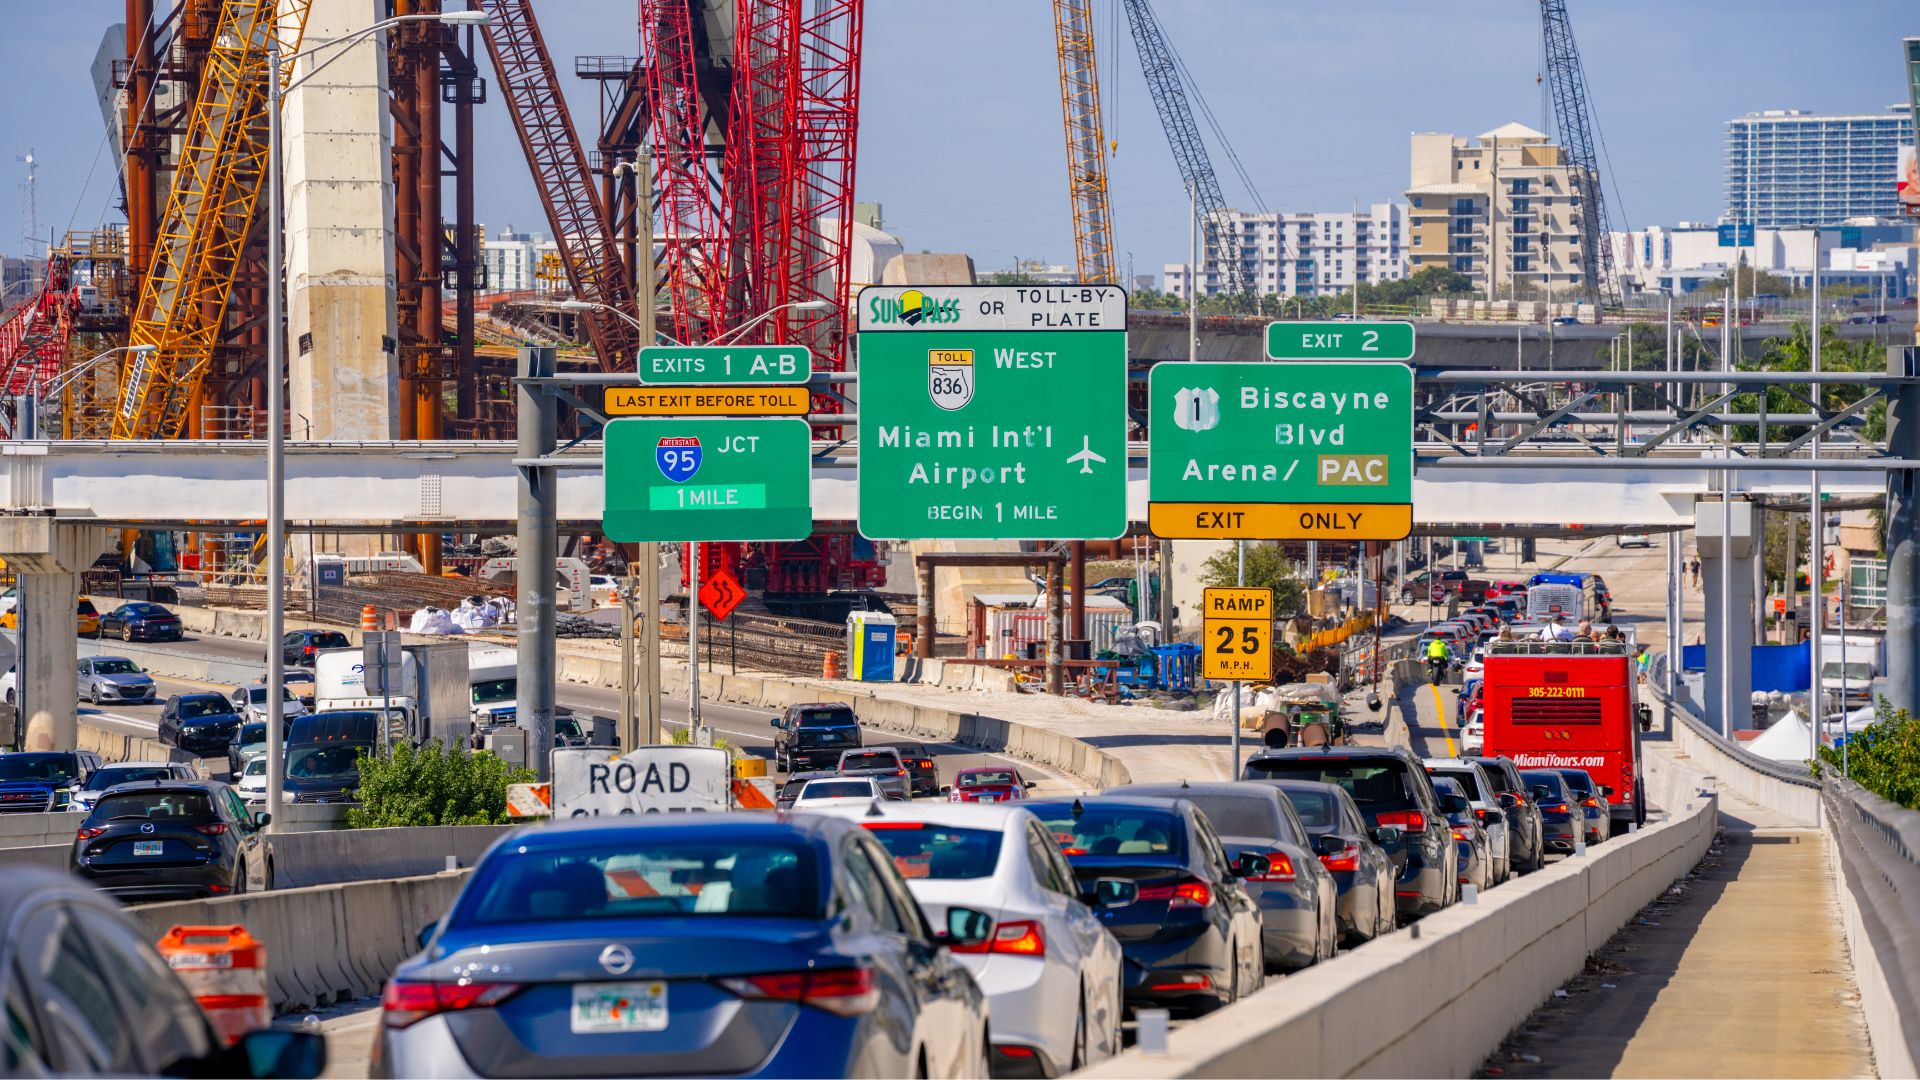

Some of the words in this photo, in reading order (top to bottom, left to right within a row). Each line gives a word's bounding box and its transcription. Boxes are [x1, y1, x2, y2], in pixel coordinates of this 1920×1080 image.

[980, 301, 1004, 315] OR
[1016, 289, 1115, 304] TOLL-BY-
[1031, 313, 1100, 327] PLATE
[1303, 333, 1343, 348] EXIT
[1361, 330, 1379, 351] 2
[652, 358, 705, 373] EXITS
[723, 355, 731, 375] 1
[749, 355, 796, 375] A-B
[937, 352, 967, 363] TOLL
[993, 348, 1057, 369] WEST
[932, 377, 962, 396] 836
[616, 395, 655, 407] LAST
[657, 395, 691, 407] EXIT
[695, 395, 754, 407] BEFORE
[758, 394, 797, 407] TOLL
[1193, 396, 1201, 421] 1
[1240, 387, 1389, 414] Biscayne
[662, 438, 696, 447] INTERSTATE
[717, 436, 760, 453] JCT
[878, 426, 974, 448] Miami
[992, 426, 1052, 448] Int'l
[1275, 424, 1345, 446] Blvd
[663, 450, 696, 472] 95
[1182, 459, 1299, 481] Arena/
[1321, 459, 1384, 482] PAC
[908, 462, 1026, 489] Airport
[676, 488, 684, 508] 1
[690, 489, 739, 506] MILE
[927, 505, 983, 520] BEGIN
[994, 502, 1003, 523] 1
[1013, 505, 1058, 520] MILE
[1196, 511, 1245, 529] EXIT
[1299, 512, 1363, 530] ONLY
[1214, 598, 1265, 611] RAMP
[1216, 626, 1260, 654] 25
[1220, 661, 1254, 670] M.P.H.
[1528, 687, 1585, 698] 305-222-0111
[1513, 753, 1605, 767] MiamiTours.com
[589, 762, 690, 794] ROAD
